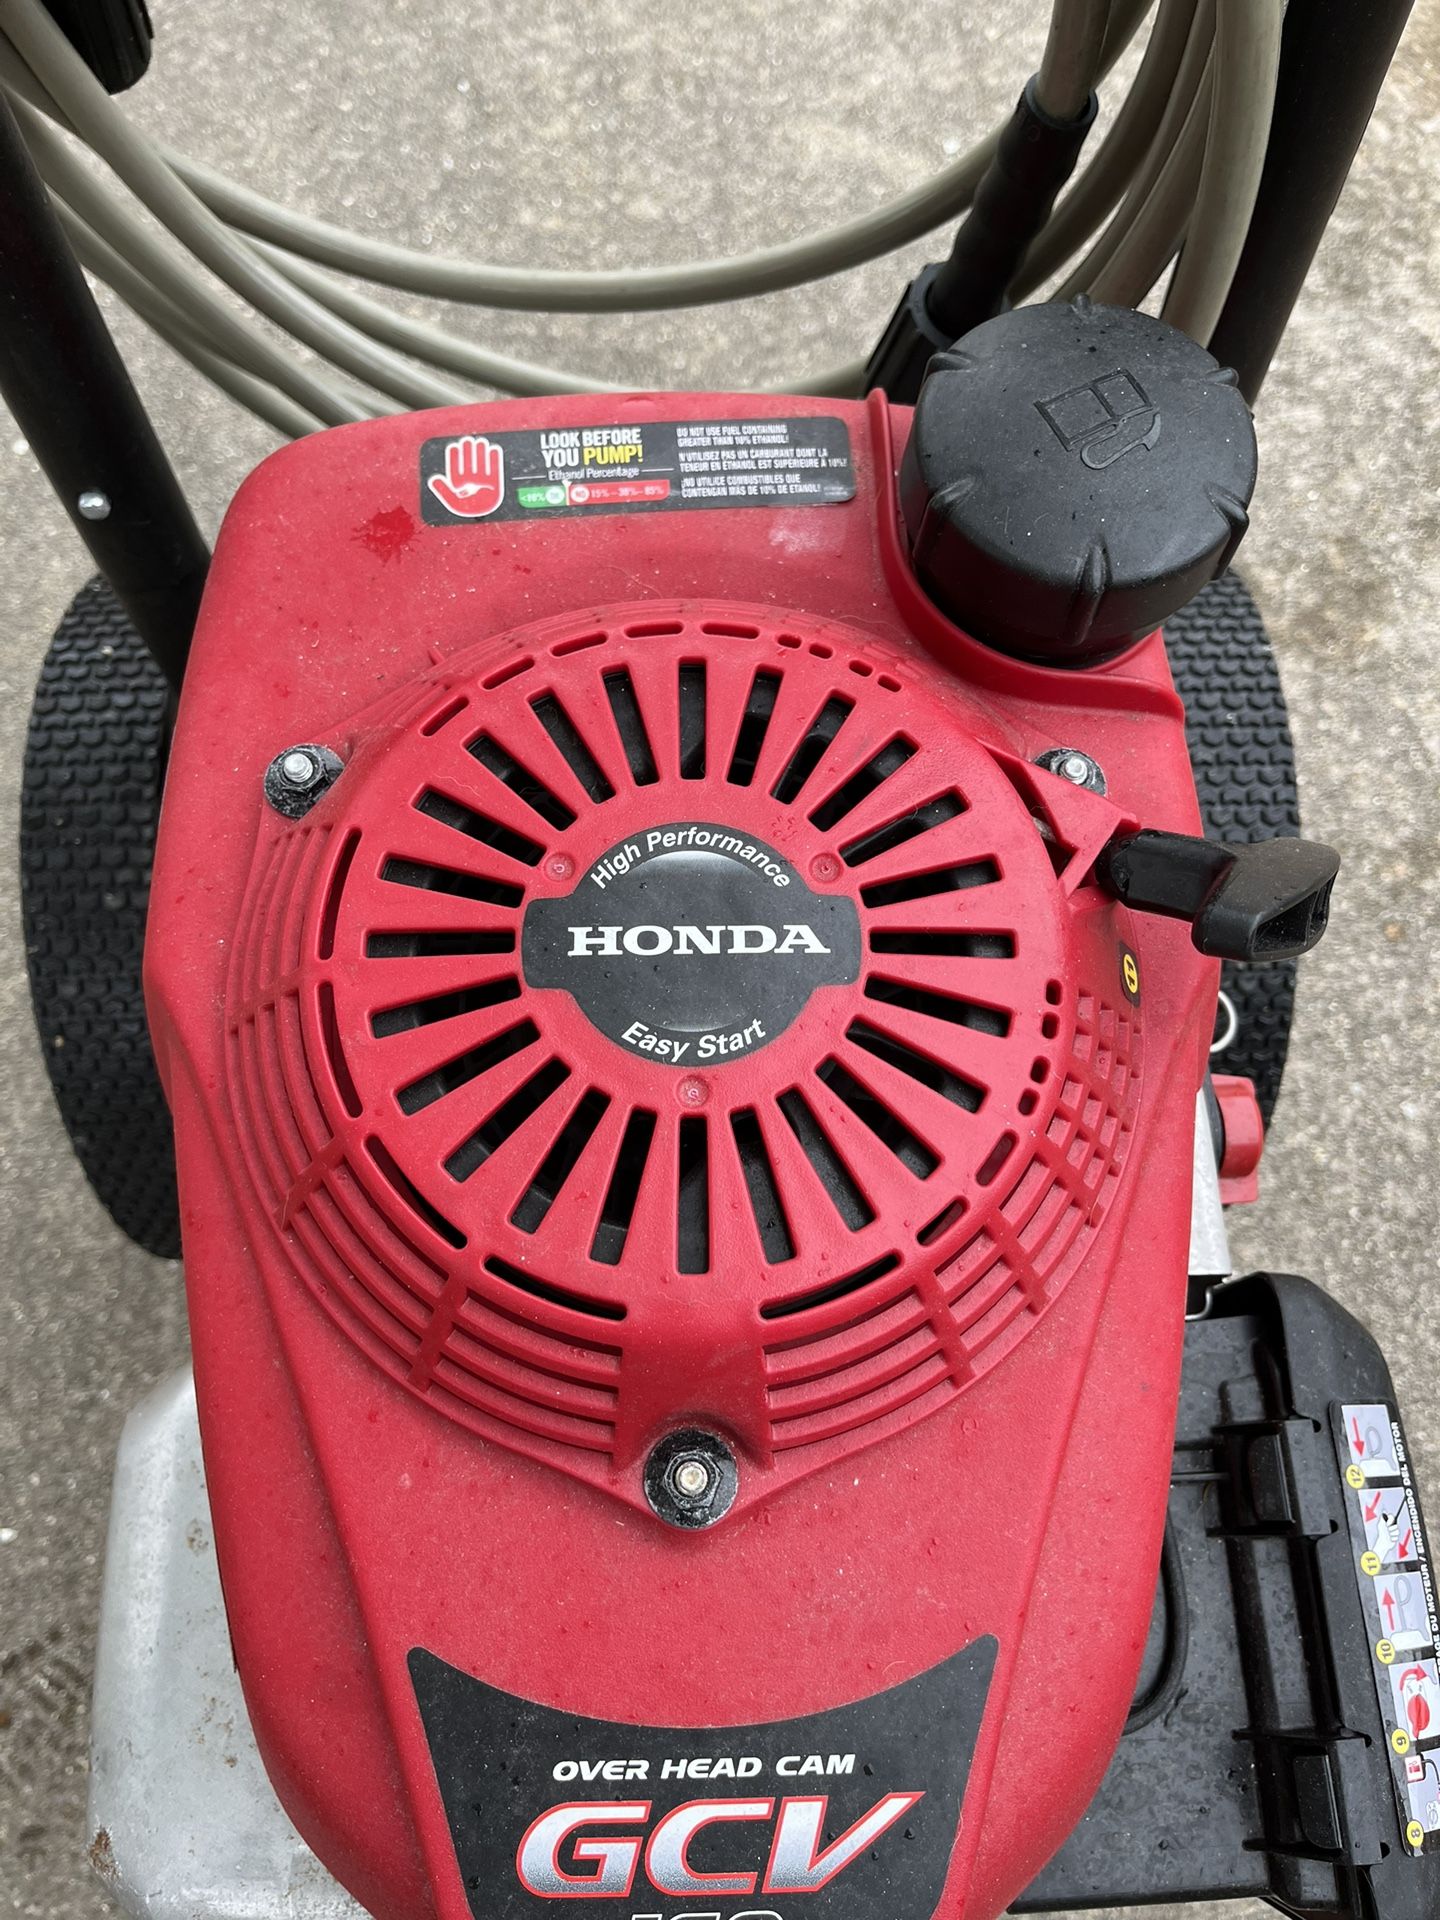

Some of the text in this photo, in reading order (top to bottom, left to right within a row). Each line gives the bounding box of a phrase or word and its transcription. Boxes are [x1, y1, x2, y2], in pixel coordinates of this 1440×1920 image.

[540, 428, 642, 450] LOOK BEFORE
[677, 435, 789, 447] GREATER THAN 10% ETHANOL!
[689, 427, 704, 436] NOT
[706, 426, 720, 436] USE
[722, 426, 741, 435] FUEL
[742, 424, 787, 435] CONTAINING
[541, 444, 643, 468] YOU PUMP!
[721, 450, 736, 460] PAS
[737, 450, 748, 459] UN
[750, 449, 794, 459] CARBURANT
[795, 448, 816, 457] DONT
[818, 448, 828, 457] LA
[548, 467, 639, 481] Ethanol Percentage
[679, 462, 709, 472] TENEUR
[711, 461, 721, 471] EN
[758, 460, 772, 469] EST
[682, 487, 727, 498] CONTENGAN
[748, 485, 758, 495] DE
[760, 485, 776, 494] 10%
[777, 485, 788, 494] DE
[789, 483, 821, 493] ETANOL!
[698, 476, 725, 486] UTILICE
[727, 474, 784, 485] COMBUSTIBLES
[786, 474, 800, 483] QUE
[590, 827, 791, 889] High Performance
[568, 925, 831, 957] HONDA
[621, 1018, 766, 1062] Easy Start
[1391, 1422, 1406, 1462] MOTOR
[1400, 1463, 1411, 1486] DEL
[1405, 1488, 1425, 1554] ENCENDIDO
[1420, 1564, 1436, 1613] MOTEUR
[1430, 1615, 1439, 1632] DU
[553, 1754, 856, 1782] OVER HEAD CAM
[516, 1791, 927, 1898] GCV
